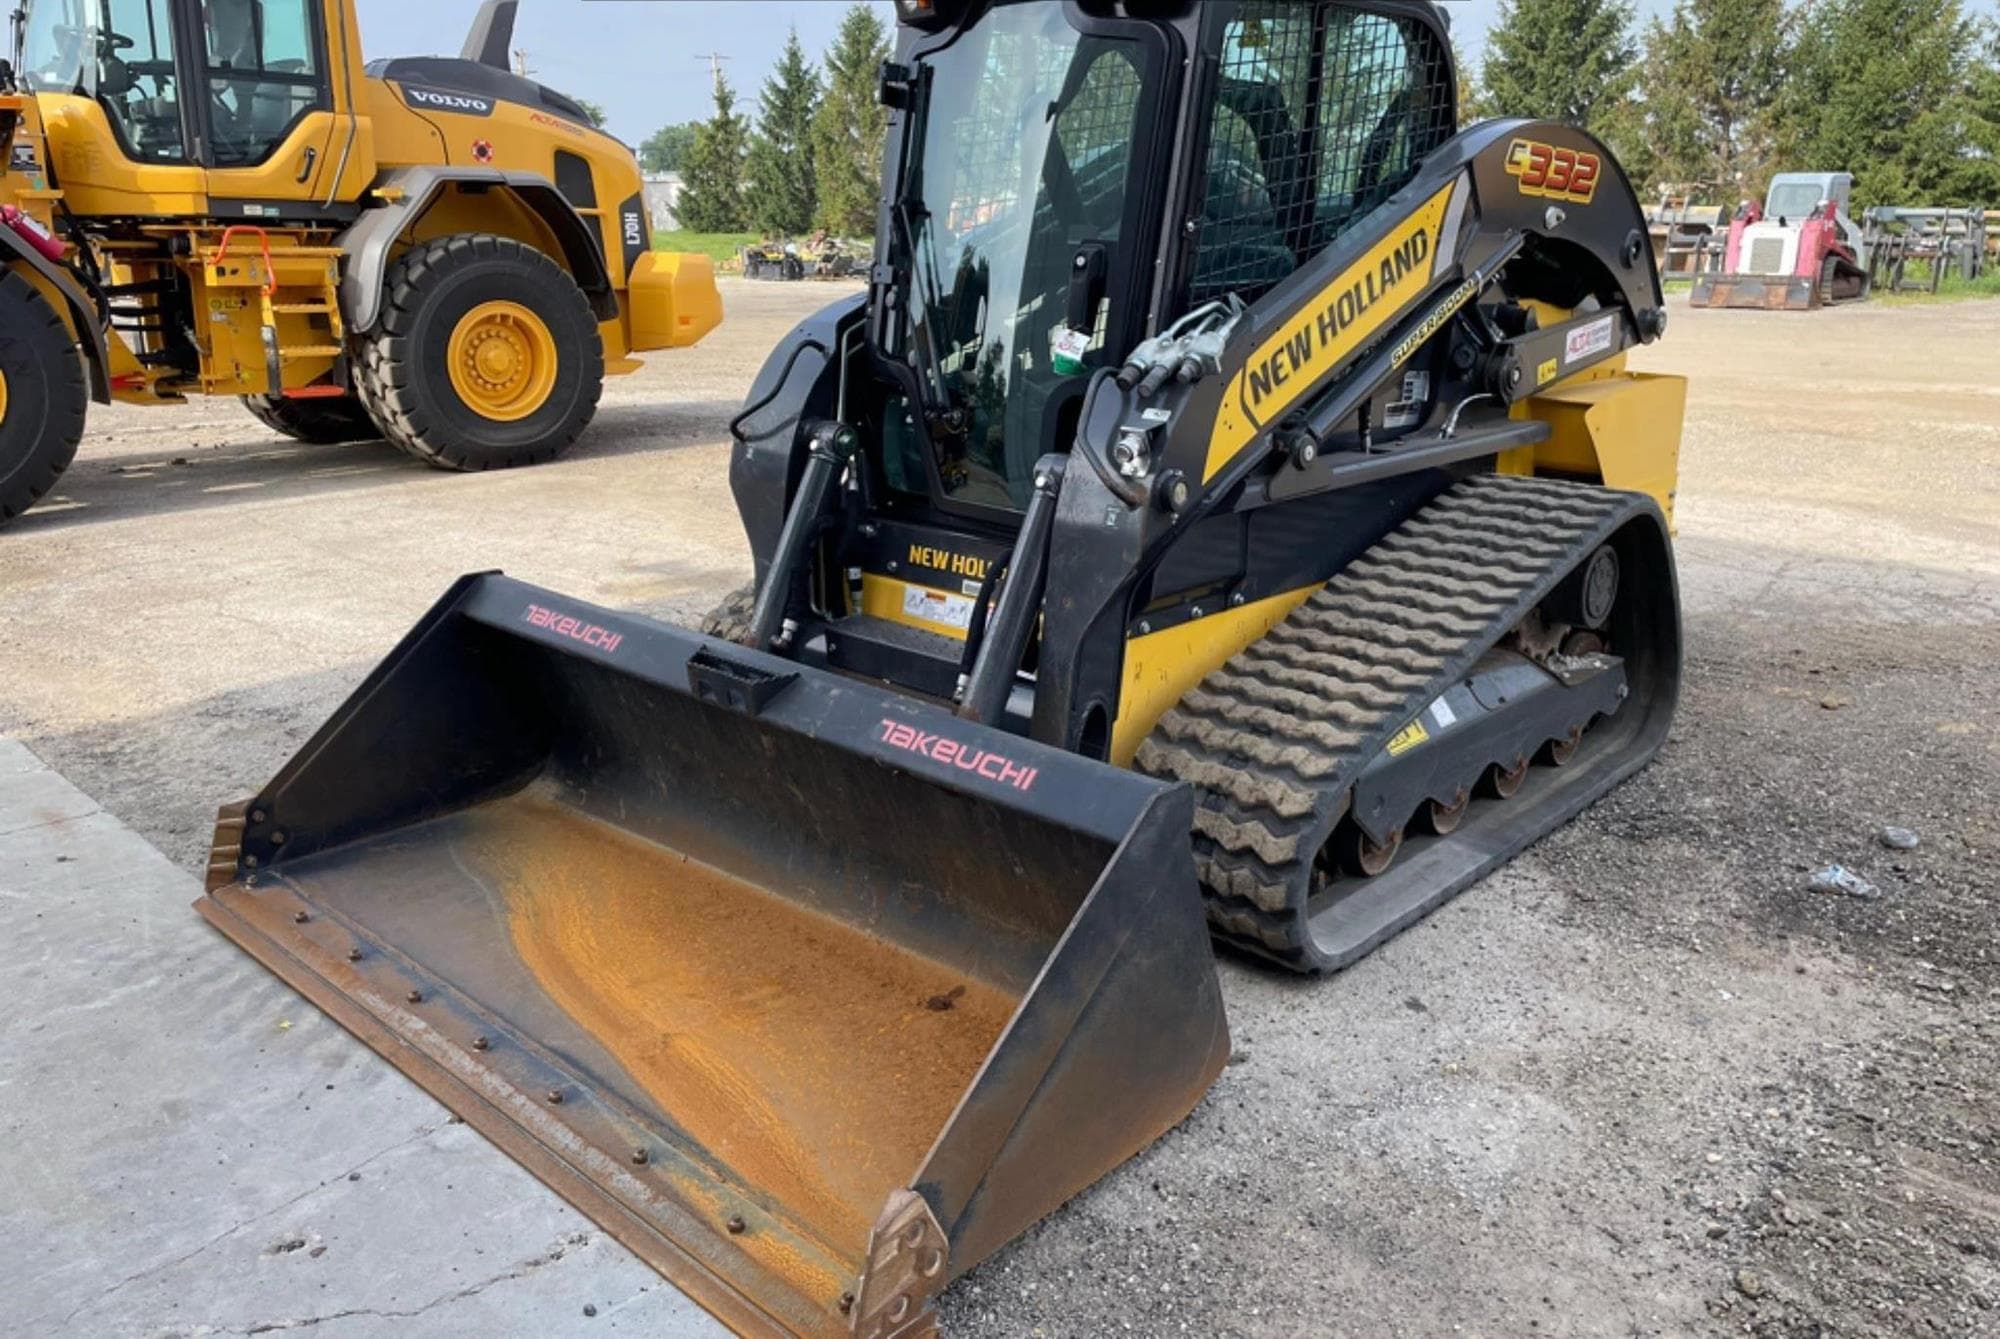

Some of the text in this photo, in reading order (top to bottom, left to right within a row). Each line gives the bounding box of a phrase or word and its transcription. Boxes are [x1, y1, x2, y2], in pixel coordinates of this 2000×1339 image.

[408, 88, 488, 112] VOLVO
[1506, 139, 1600, 203] C332
[624, 212, 640, 245] L70H
[1249, 324, 1312, 405] NEW
[1316, 227, 1428, 348] HOLLAND
[909, 544, 950, 570] NEW
